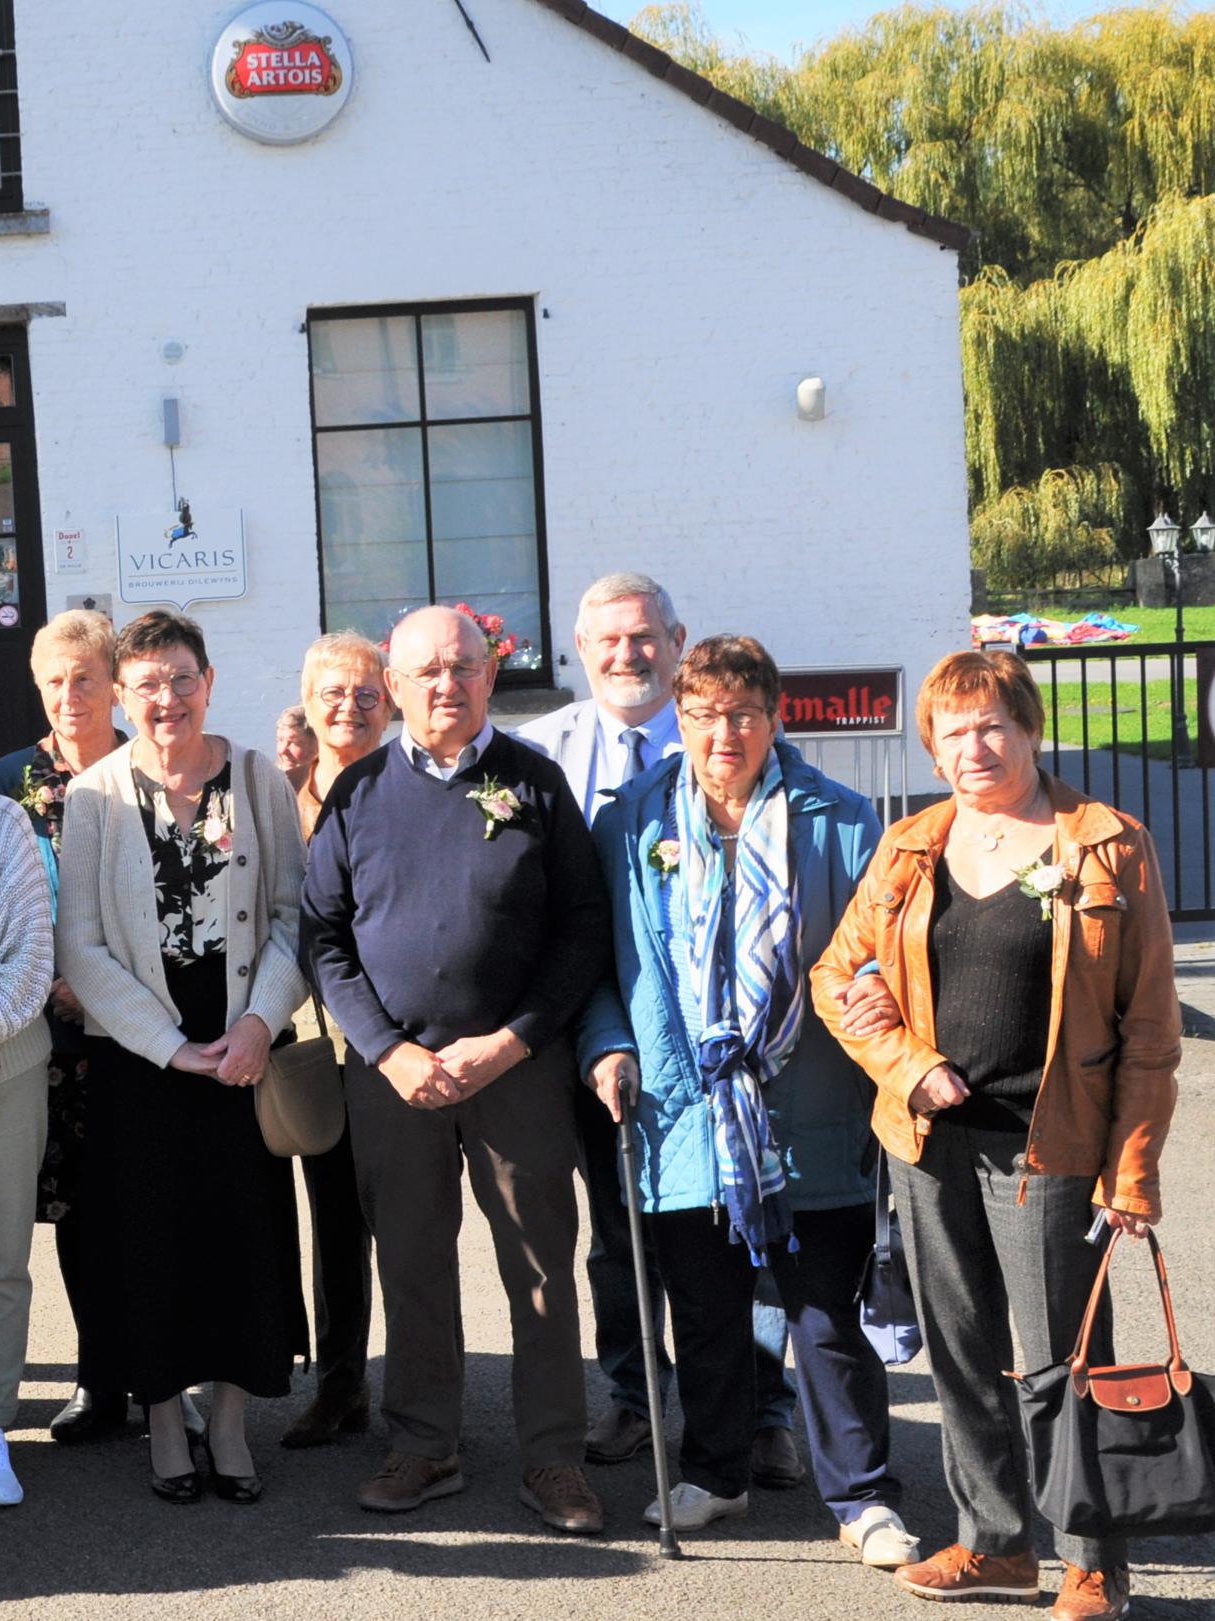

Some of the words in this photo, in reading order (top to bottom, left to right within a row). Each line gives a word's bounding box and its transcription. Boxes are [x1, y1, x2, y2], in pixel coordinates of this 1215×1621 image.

[247, 51, 322, 69] STELLA
[247, 68, 323, 86] ARTOIS
[130, 550, 235, 570] VICARIS
[128, 580, 185, 588] BROUWERIJ
[779, 686, 892, 723] tmalle
[836, 716, 885, 725] TRAPPIST
